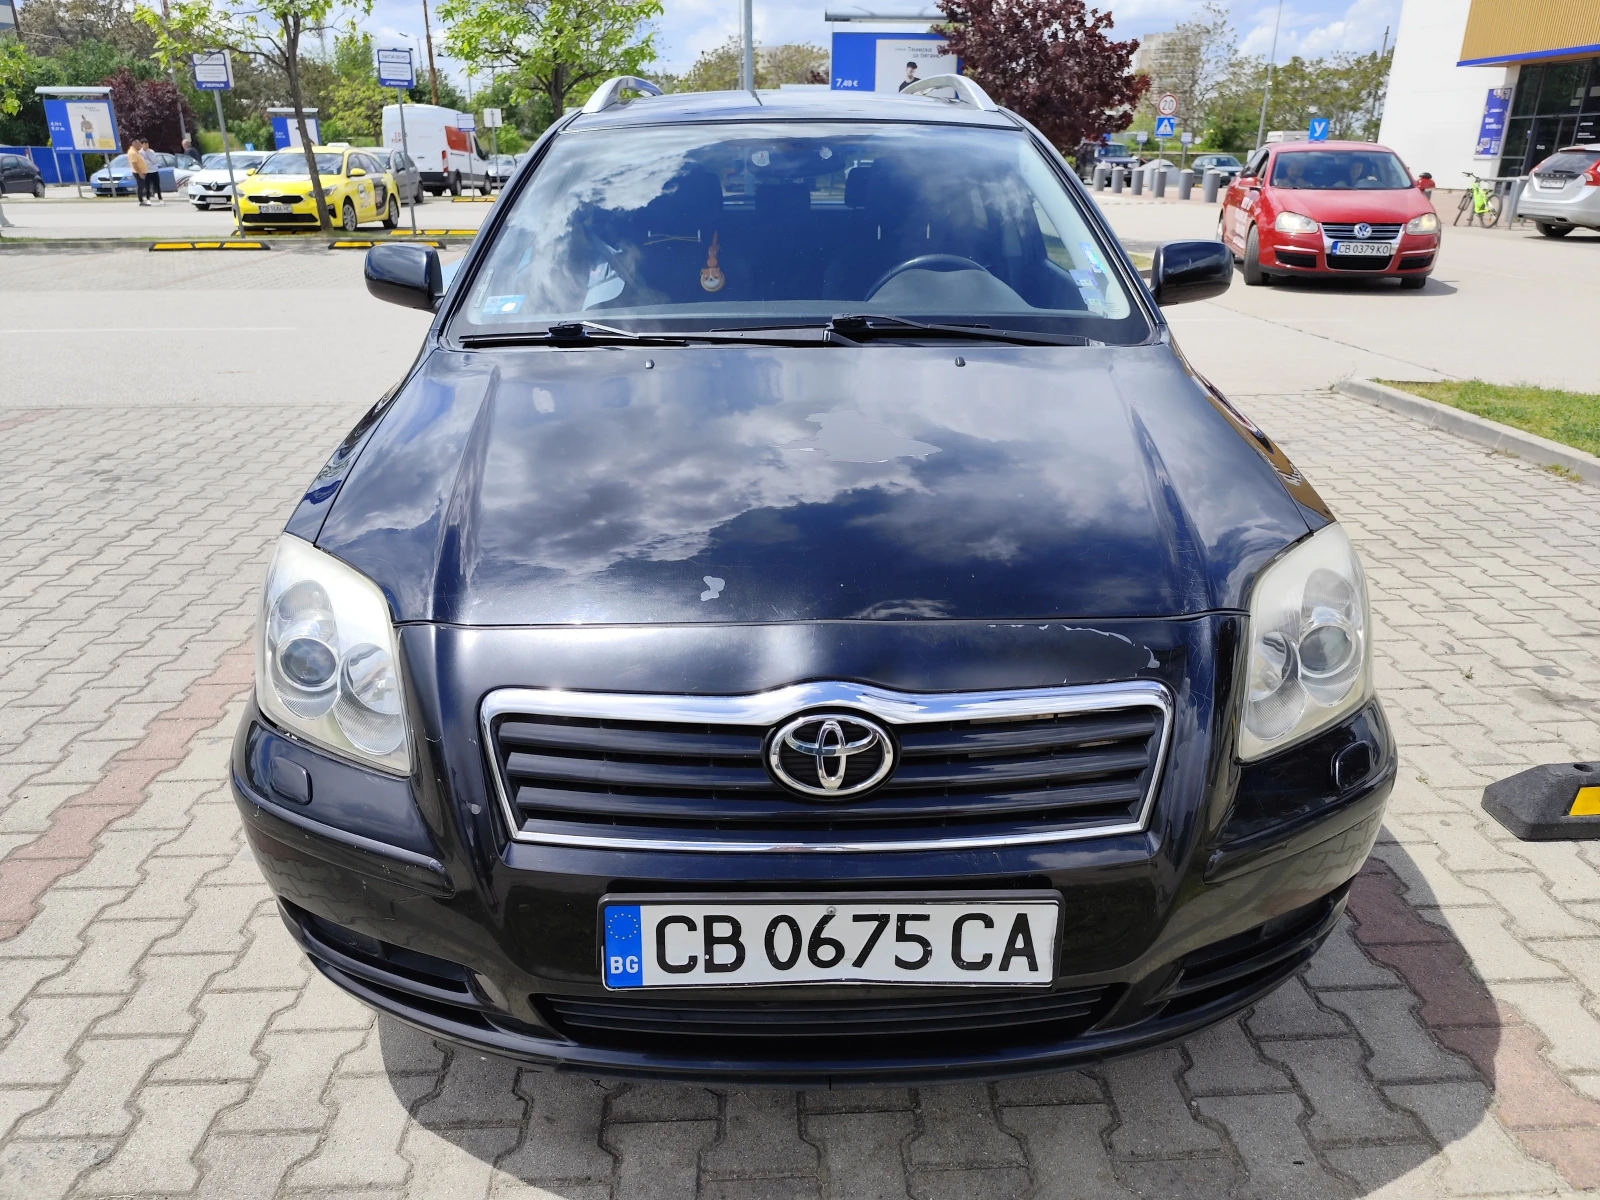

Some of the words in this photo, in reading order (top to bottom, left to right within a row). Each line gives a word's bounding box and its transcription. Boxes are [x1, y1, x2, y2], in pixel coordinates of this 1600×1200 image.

[1162, 99, 1175, 111] 20
[1338, 244, 1351, 254] CB
[1352, 244, 1376, 254] 0379
[655, 913, 745, 974] CB
[764, 912, 933, 971] 0675
[950, 912, 1039, 972] CA
[610, 955, 639, 974] BG
